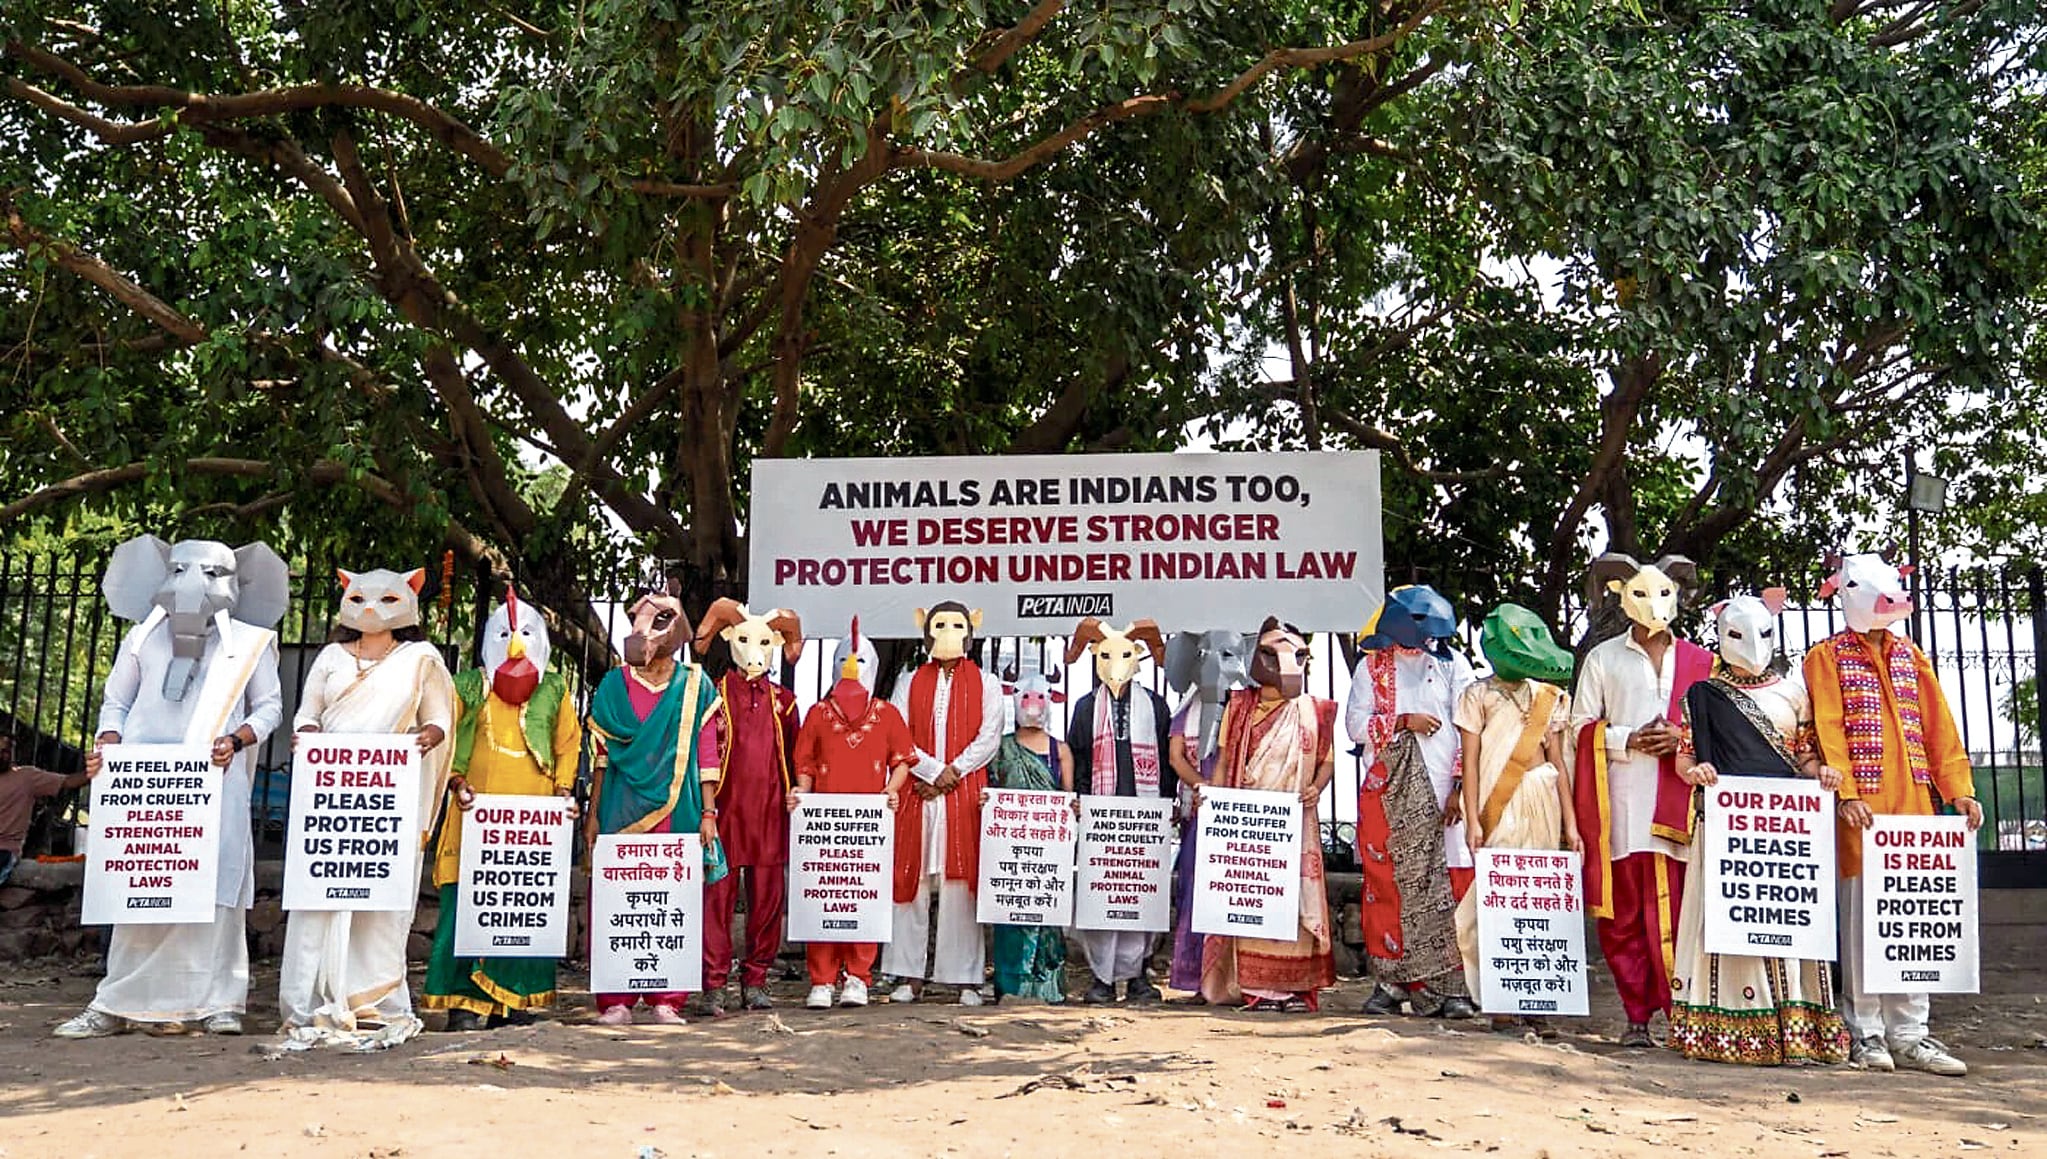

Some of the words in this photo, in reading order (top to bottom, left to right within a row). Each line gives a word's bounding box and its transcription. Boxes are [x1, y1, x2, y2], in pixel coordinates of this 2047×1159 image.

[819, 480, 980, 509] ANIMALS
[988, 479, 1059, 506] ARE
[1069, 475, 1217, 504] INDIANS
[1225, 475, 1309, 507] TOO,
[851, 519, 907, 546] WE
[917, 516, 1077, 545] DESERVE
[1087, 514, 1279, 542] STRONGER
[775, 555, 998, 585] PROTECTION
[1008, 553, 1131, 582] UNDER
[1140, 552, 1266, 579] INDIAN
[1276, 551, 1356, 579] LAW
[307, 748, 352, 764] OUR
[357, 749, 408, 765] PAIN
[108, 761, 132, 772] WE
[135, 761, 170, 772] FEEL
[174, 761, 208, 772] PAIN
[110, 777, 143, 789] AND
[146, 777, 203, 788] SUFFER
[315, 770, 335, 786] IS
[340, 771, 395, 787] REAL
[100, 794, 142, 805] FROM
[146, 793, 211, 805] CRUELTY
[313, 793, 395, 810] PLEASE
[1717, 791, 1763, 809] OUR
[1769, 793, 1820, 811] PAIN
[127, 810, 183, 821] PLEASE
[802, 807, 821, 817] WE
[824, 808, 852, 817] FEEL
[855, 808, 882, 818] PAIN
[1090, 808, 1107, 817] WE
[1109, 809, 1135, 818] FEEL
[1137, 810, 1162, 819] PAIN
[1211, 800, 1229, 810] WE
[1232, 802, 1260, 813] FEEL
[1262, 805, 1290, 816] PAIN
[304, 815, 402, 832] PROTECT
[474, 808, 514, 824] OUR
[519, 809, 562, 825] PAIN
[1213, 814, 1239, 824] AND
[1241, 816, 1286, 829] SUFFER
[1728, 814, 1748, 830] IS
[1754, 815, 1810, 834] REAL
[104, 826, 203, 838] STRENGTHEN
[806, 821, 831, 831] AND
[833, 822, 878, 832] SUFFER
[1092, 820, 1116, 830] AND
[1118, 821, 1158, 831] SUFFER
[482, 829, 499, 844] IS
[504, 830, 552, 845] REAL
[798, 834, 831, 844] FROM
[833, 835, 885, 845] CRUELTY
[1085, 832, 1115, 842] FROM
[1118, 833, 1164, 844] CRUELTY
[1205, 826, 1238, 838] FROM
[1241, 829, 1293, 842] CRUELTY
[1875, 830, 1915, 847] OUR
[1920, 831, 1964, 847] PAIN
[123, 842, 181, 854] ANIMAL
[304, 838, 332, 854] US
[337, 838, 398, 855] FROM
[615, 844, 658, 859] हमारा
[661, 838, 684, 858] दर्द
[819, 848, 863, 858] PLEASE
[1104, 845, 1145, 855] PLEASE
[1226, 841, 1270, 854] PLEASE
[1728, 837, 1810, 857] PLEASE
[104, 859, 198, 871] PROTECTION
[481, 849, 551, 865] PLEASE
[1089, 857, 1159, 868] STRENGTHEN
[1208, 854, 1287, 869] STRENGTHEN
[1491, 854, 1510, 867] हम
[1514, 855, 1548, 870] क्रूरता
[1551, 856, 1568, 868] का
[1884, 853, 1901, 869] IS
[1906, 853, 1956, 870] REAL
[309, 861, 389, 878] CRIMES
[602, 862, 669, 880] वास्तविक
[802, 861, 880, 872] STRENGTHEN
[1224, 868, 1270, 881] ANIMAL
[1720, 859, 1819, 880] PROTECT
[129, 876, 172, 887] LAWS
[472, 870, 557, 886] PROTECT
[818, 875, 863, 885] ANIMAL
[1103, 870, 1144, 880] ANIMAL
[1488, 870, 1529, 887] शिकार
[1532, 872, 1561, 889] बनते
[1564, 872, 1574, 891] हैं
[1090, 882, 1157, 893] PROTECTION
[1209, 880, 1283, 896] PROTECTION
[1721, 881, 1750, 899] US
[1756, 884, 1817, 903] FROM
[1884, 876, 1956, 893] PLEASE
[473, 890, 497, 906] US
[502, 891, 554, 906] FROM
[625, 891, 669, 909] कृपया
[803, 888, 877, 899] PROTECTION
[1108, 895, 1138, 904] LAWS
[1483, 890, 1505, 908] और
[1510, 891, 1527, 909] दर्द
[1531, 892, 1561, 911] सहते
[823, 902, 857, 912] LAWS
[1229, 896, 1263, 908] LAWS
[1877, 898, 1963, 915] PROTECT
[477, 911, 547, 927] CRIMES
[610, 907, 667, 927] अपराधों
[670, 907, 684, 927] से
[1729, 905, 1810, 926] CRIMES
[1513, 918, 1549, 933] कृपया
[1878, 921, 1903, 938] US
[1908, 921, 1961, 938] FROM
[608, 930, 652, 952] हमारी
[655, 935, 684, 950] रक्षा
[1501, 937, 1523, 954] पशु
[1526, 935, 1568, 952] संरक्षण
[1884, 944, 1955, 961] CRIMES
[633, 953, 659, 971] करें
[1492, 957, 1530, 975] कानून
[1533, 954, 1551, 971] को
[1554, 954, 1578, 975] और
